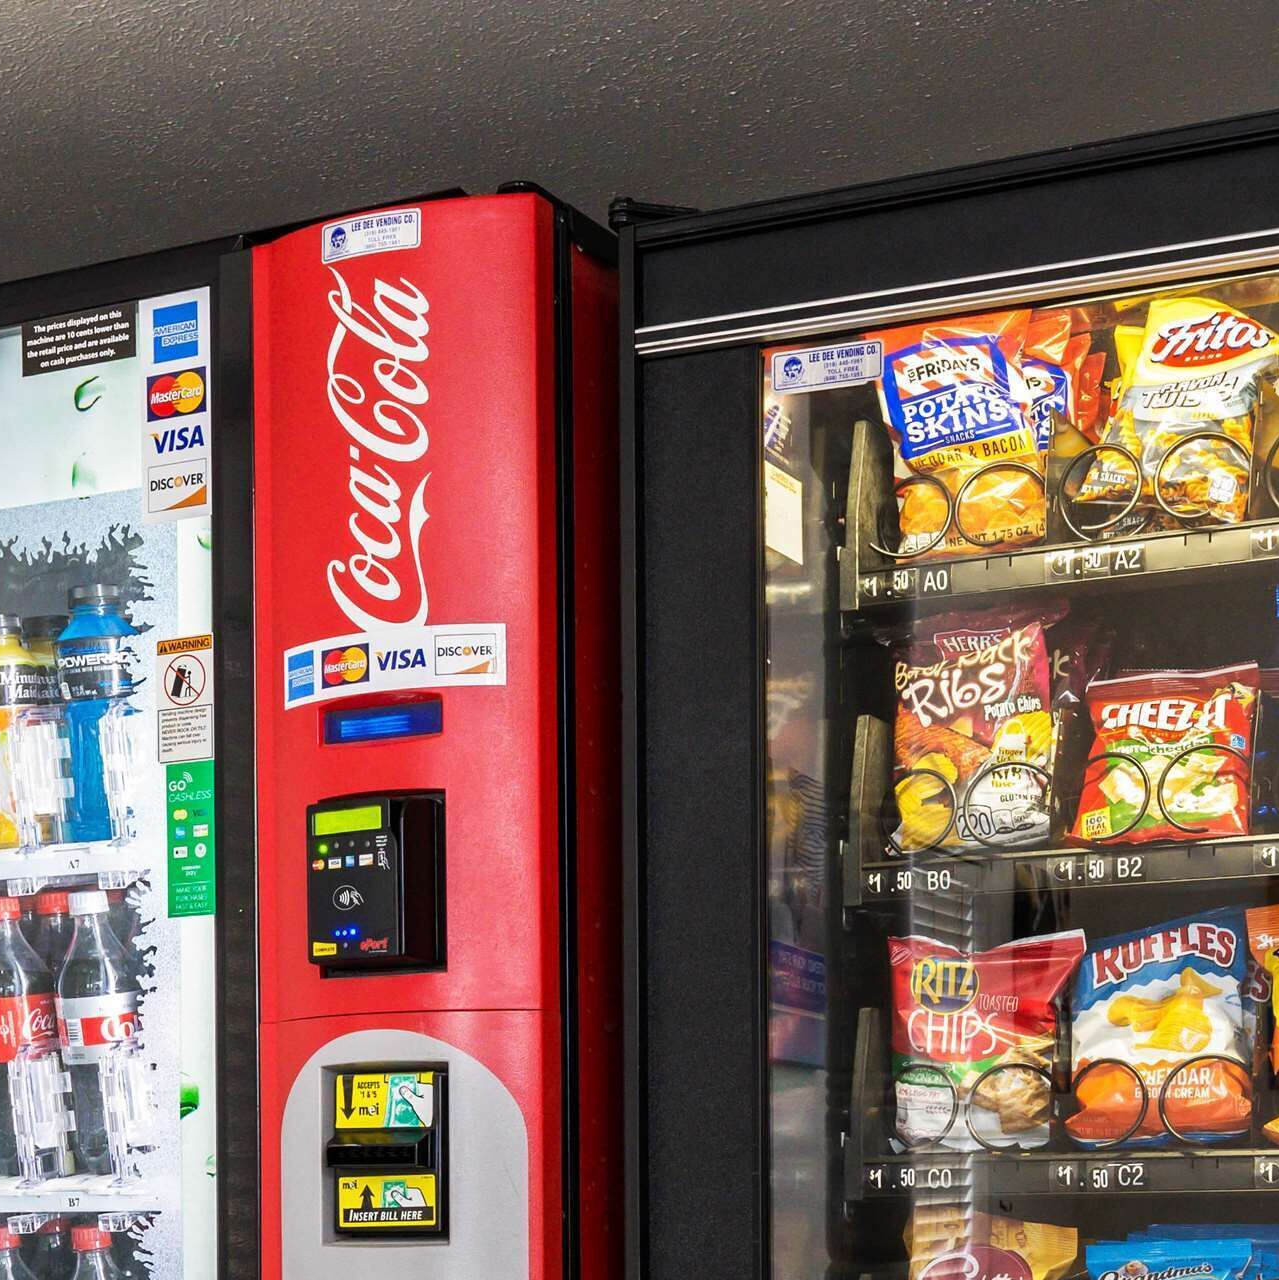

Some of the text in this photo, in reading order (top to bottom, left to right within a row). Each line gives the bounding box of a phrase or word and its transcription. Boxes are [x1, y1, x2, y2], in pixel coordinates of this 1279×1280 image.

[47, 321, 67, 333] prices
[67, 314, 98, 327] displayed
[109, 310, 122, 319] this
[154, 321, 195, 337] AMERICAN
[26, 336, 54, 347] machine
[76, 328, 93, 337] cents
[94, 325, 113, 334] lower
[113, 321, 130, 330] than
[162, 332, 198, 346] EXPRESS
[1151, 312, 1274, 363] Fritos
[27, 350, 38, 358] the
[39, 346, 56, 356] retail
[56, 344, 73, 355] price
[74, 341, 87, 350] and
[99, 333, 130, 345] available
[809, 344, 878, 363] LEE DEE VENDING CO.
[50, 357, 64, 366] cash
[65, 352, 98, 365] purchases
[99, 347, 116, 357] only.
[150, 384, 202, 405] MasterCard
[906, 399, 1008, 443] SKINS
[151, 424, 204, 454] VISA
[945, 430, 975, 444] SNACKS
[982, 434, 1026, 456] BACON
[325, 266, 431, 632] Coca-Cola
[150, 473, 203, 492] DISCOVER
[1115, 549, 1140, 570] A2
[923, 570, 948, 590] A0
[167, 638, 210, 651] WARNING
[437, 645, 492, 657] DISCOVER
[943, 633, 1002, 652] HERR'S
[324, 658, 366, 674] MasterCard
[376, 648, 426, 671] VISA
[984, 696, 1041, 721] Potato Chips
[168, 780, 186, 791] GO
[168, 790, 212, 802] CASHLESS
[69, 859, 81, 869] A7
[1117, 857, 1142, 877] B2
[927, 871, 951, 890] B0
[1094, 923, 1237, 988] RUFFLES
[912, 957, 979, 1004] RITZ
[980, 996, 1018, 1011] TOASTED
[908, 1010, 998, 1056] CHIPS
[357, 1081, 380, 1089] ACCEPTS
[1173, 1086, 1210, 1099] CREAM
[359, 1102, 379, 1116] mei
[69, 1198, 79, 1207] B7
[349, 1210, 422, 1222] INSERT BILL HERE
